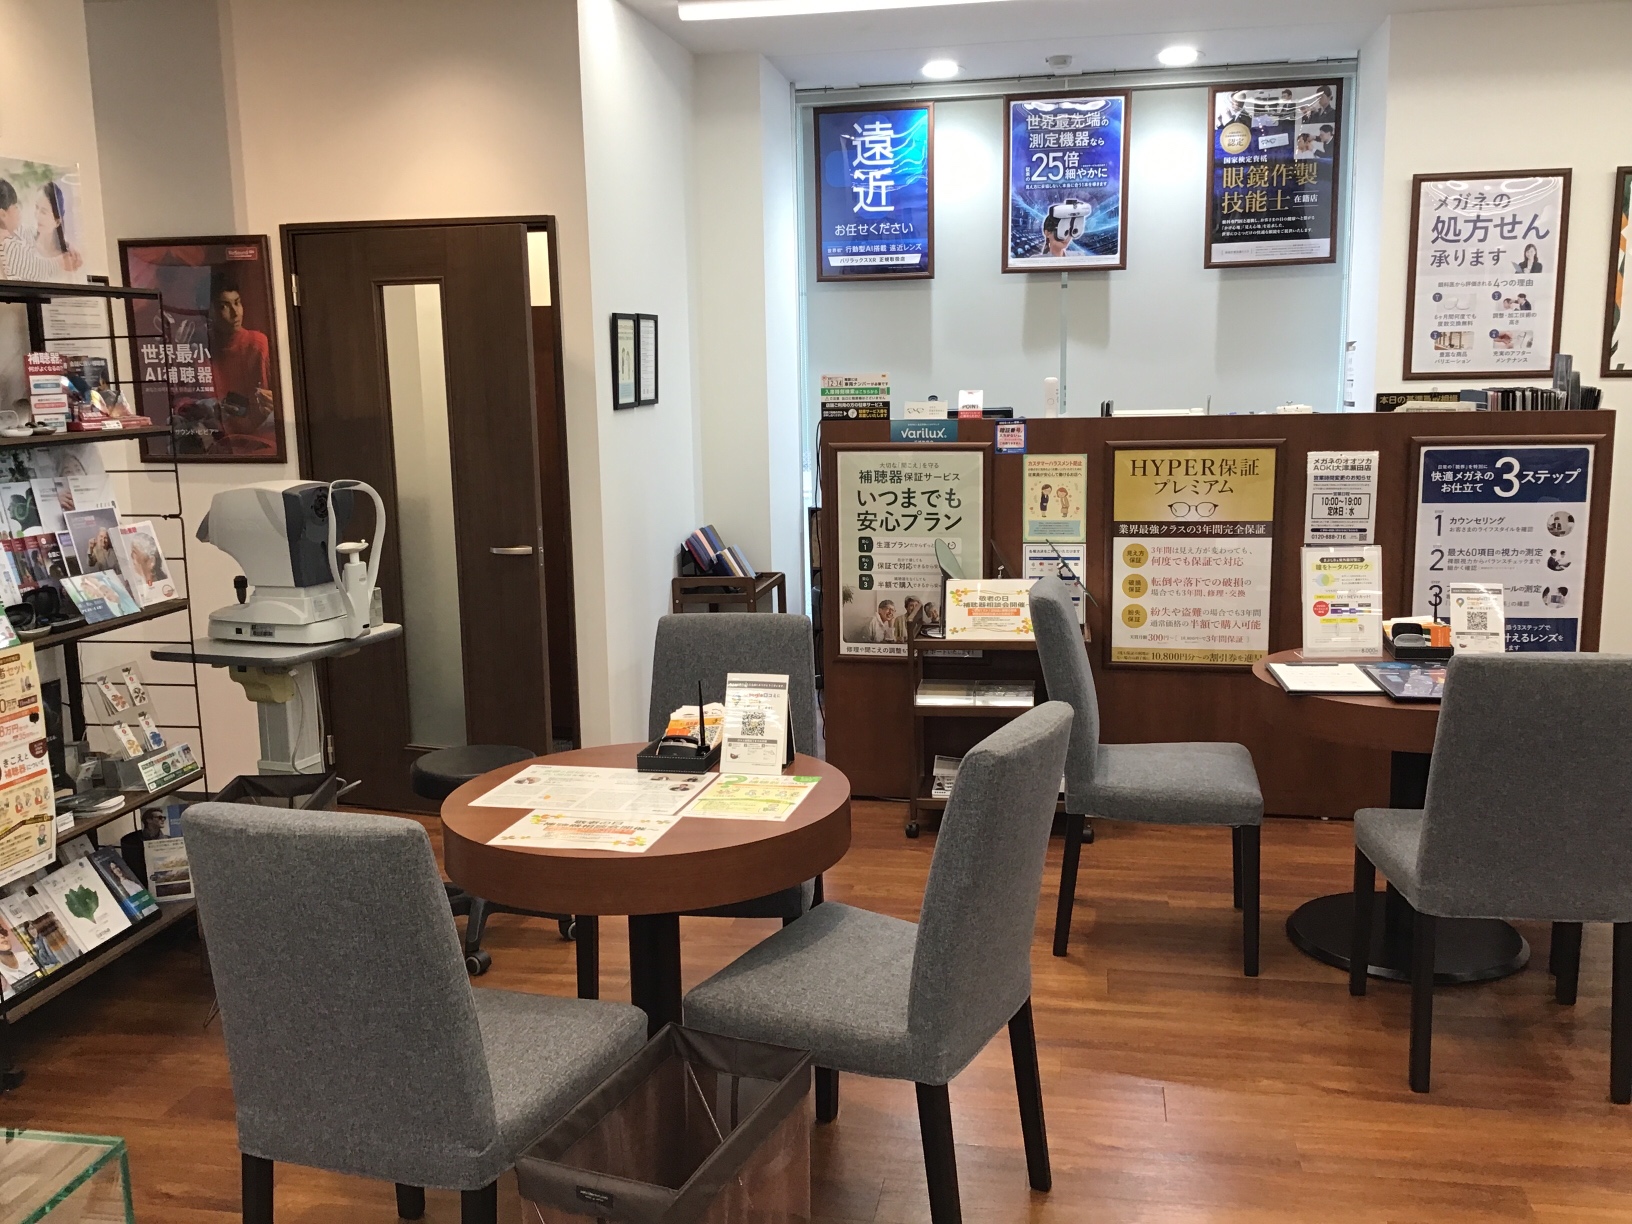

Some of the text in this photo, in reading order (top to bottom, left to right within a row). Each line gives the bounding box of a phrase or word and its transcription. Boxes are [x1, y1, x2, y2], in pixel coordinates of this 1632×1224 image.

[1026, 112, 1109, 130] 世界最先端の
[1029, 131, 1104, 148] 測定機器なら
[1223, 155, 1268, 163] 国家検定資格
[1065, 168, 1107, 179] 細やかに
[1223, 163, 1318, 188] 眼鏡作製
[1222, 190, 1290, 214] 技能士
[1434, 193, 1511, 211] メガネの
[834, 223, 913, 236] お任せください
[1431, 214, 1550, 244] 処方せん
[1430, 248, 1506, 267] 承ります
[141, 343, 211, 364] 世界最小
[146, 367, 212, 383] AI補聴器
[1130, 458, 1260, 477] HYPER保証
[859, 470, 960, 484] 補聴器保証サービス
[1431, 471, 1494, 482] 快適メガネの
[1154, 479, 1234, 495] プレミアム
[1441, 483, 1484, 493] お仕立て
[857, 488, 961, 509] いつまでも
[857, 510, 962, 532] 安心プラン
[1435, 514, 1442, 536] 1
[1450, 517, 1505, 525] カウンセリング
[1119, 524, 1266, 535] 業界最強クラスの3年間完全保証
[1151, 547, 1252, 555] 3年間は見え方が変わっても、
[1447, 548, 1543, 557] 最大60項目の視力の測定
[1151, 557, 1244, 566] 何度でも保証で対応
[1429, 549, 1444, 571] 2
[1151, 577, 1252, 587] 転倒や落下での破損の
[1150, 607, 1261, 617] 紛失や盗難の場合でも3年間
[1150, 619, 1261, 630] 通常価格の半額で購入可能
